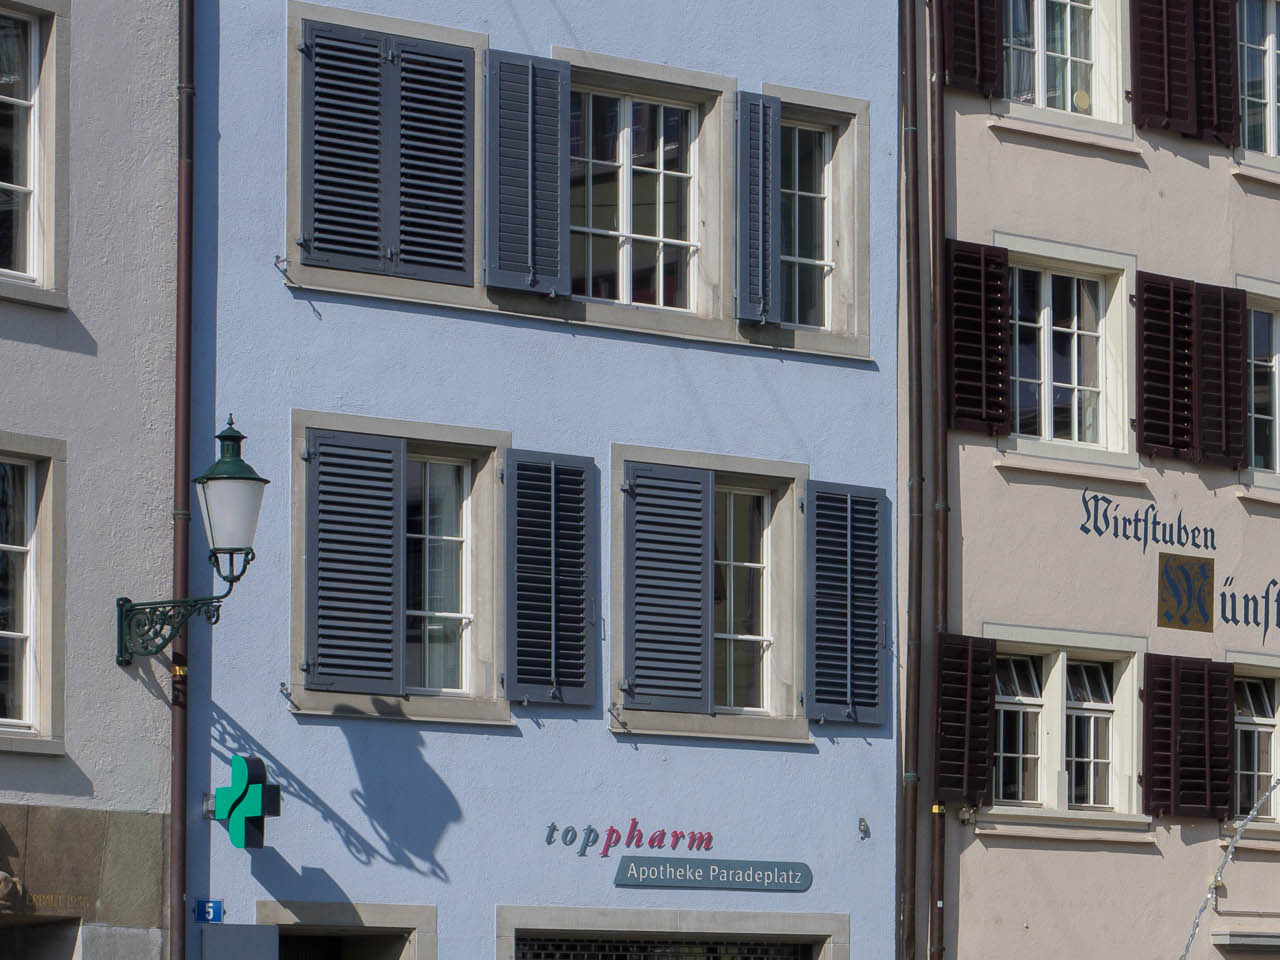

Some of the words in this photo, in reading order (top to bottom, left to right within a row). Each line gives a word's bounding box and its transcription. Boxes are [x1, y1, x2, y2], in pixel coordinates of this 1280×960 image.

[545, 817, 714, 857] toppharm
[627, 863, 704, 882] Apotheke
[710, 865, 802, 887] Paradeplatz
[205, 903, 214, 920] 5
